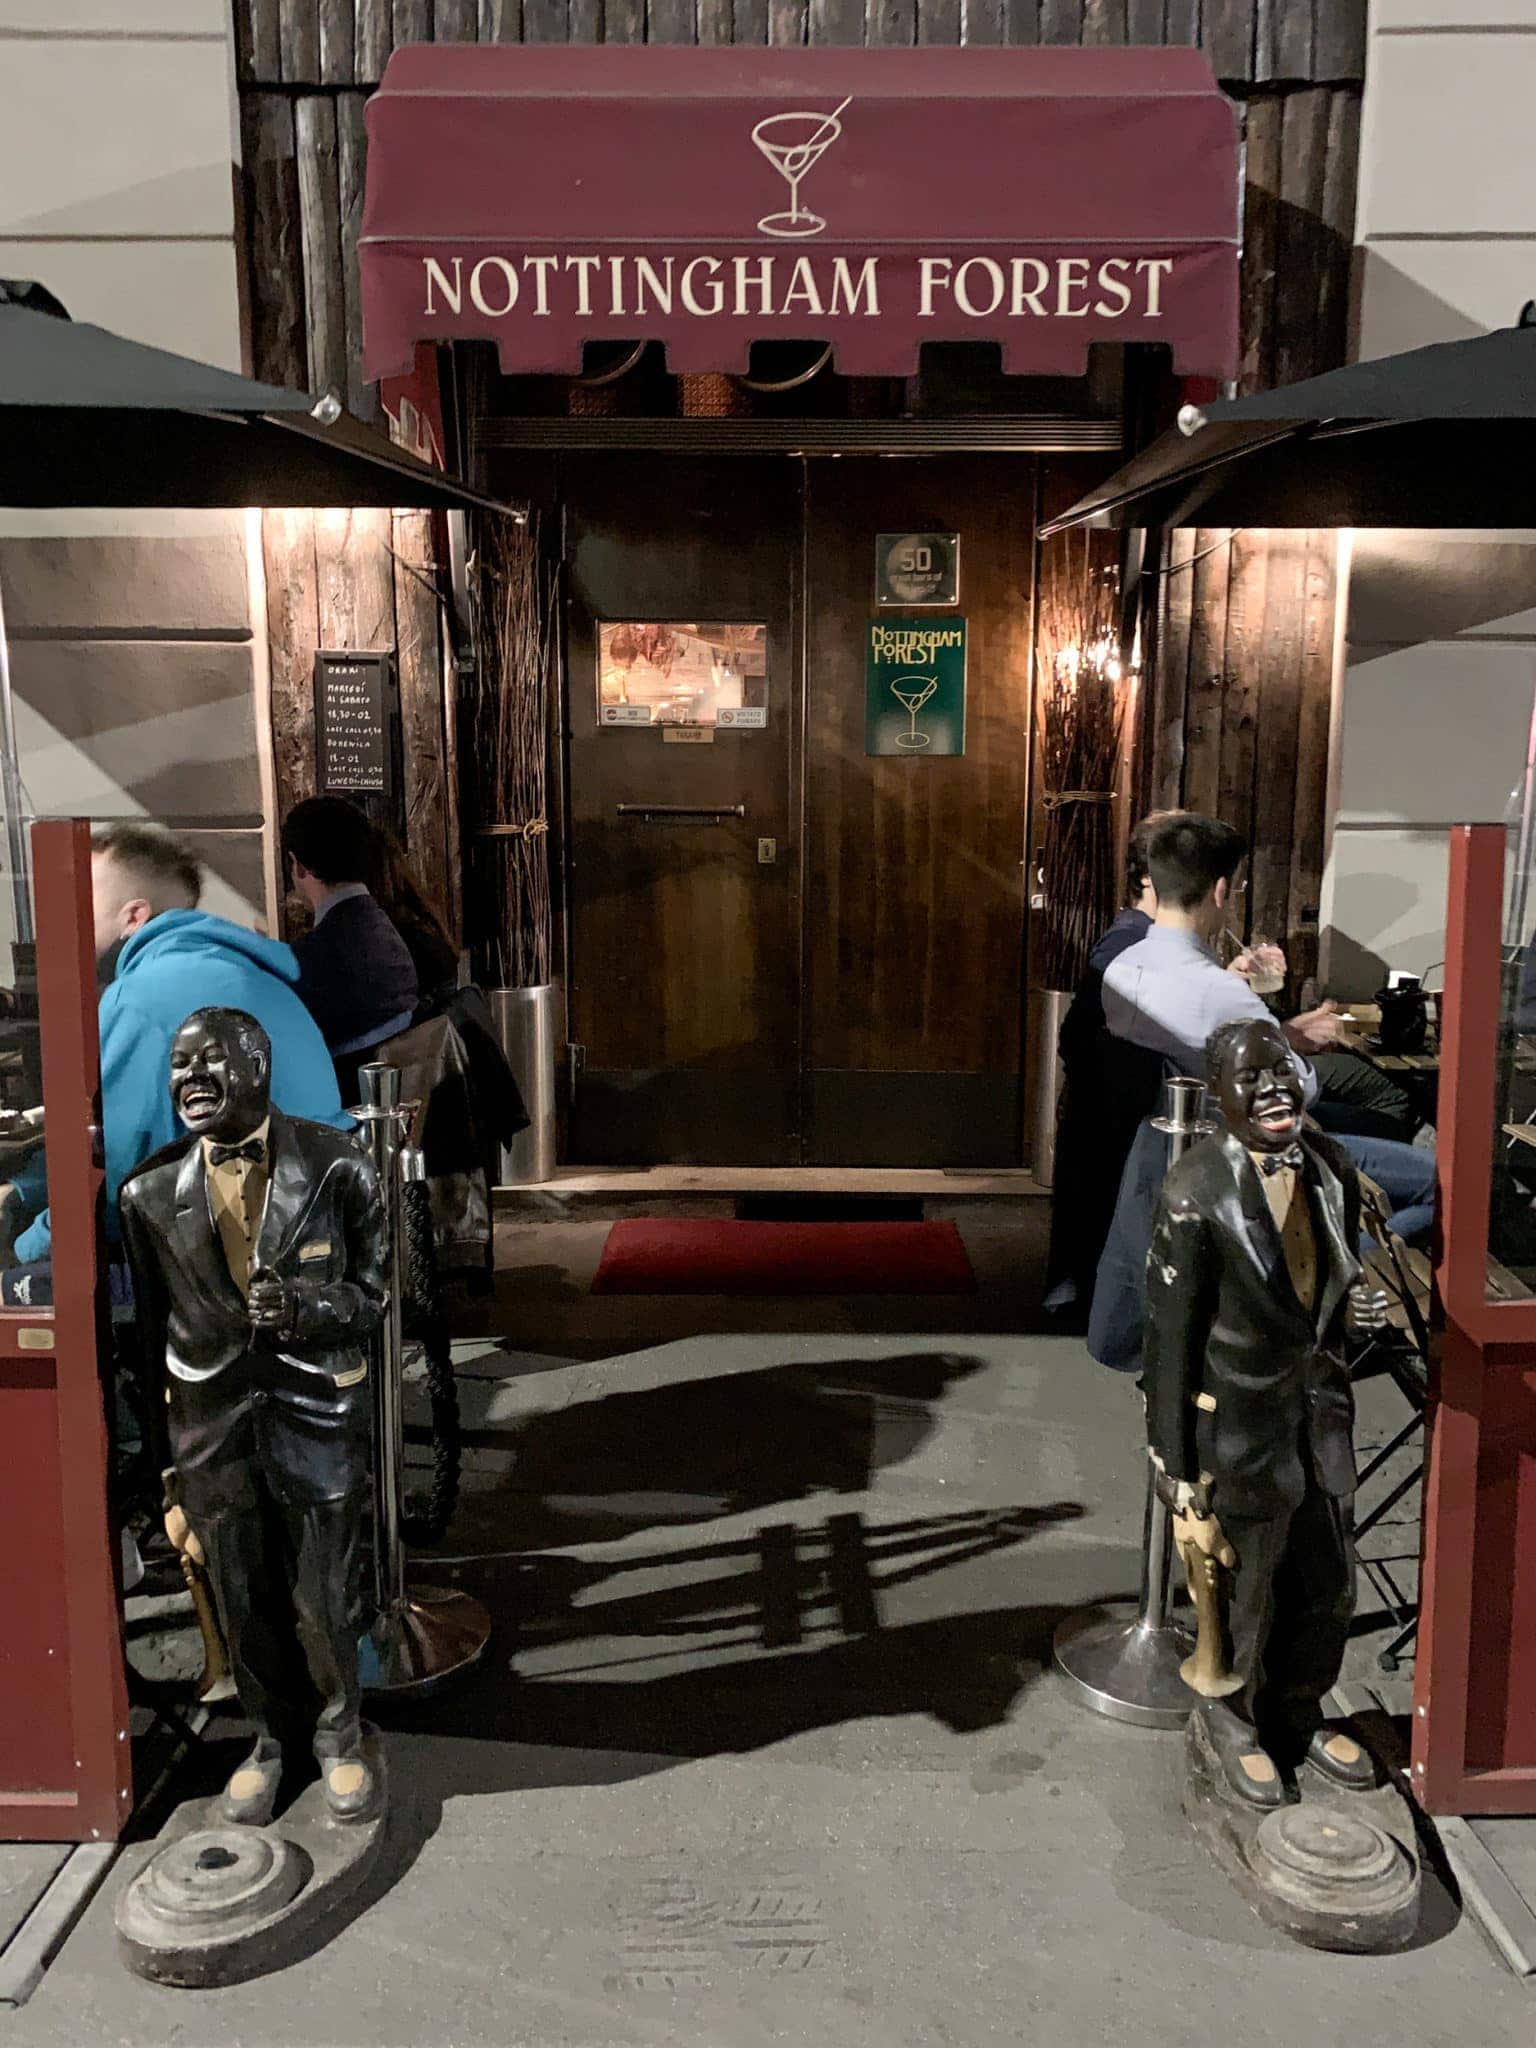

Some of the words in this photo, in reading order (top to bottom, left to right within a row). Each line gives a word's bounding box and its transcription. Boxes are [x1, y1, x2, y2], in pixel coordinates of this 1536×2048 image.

[423, 256, 881, 319] NOTTINGHAM
[917, 257, 1175, 319] FOREST
[874, 644, 936, 664] FOREST
